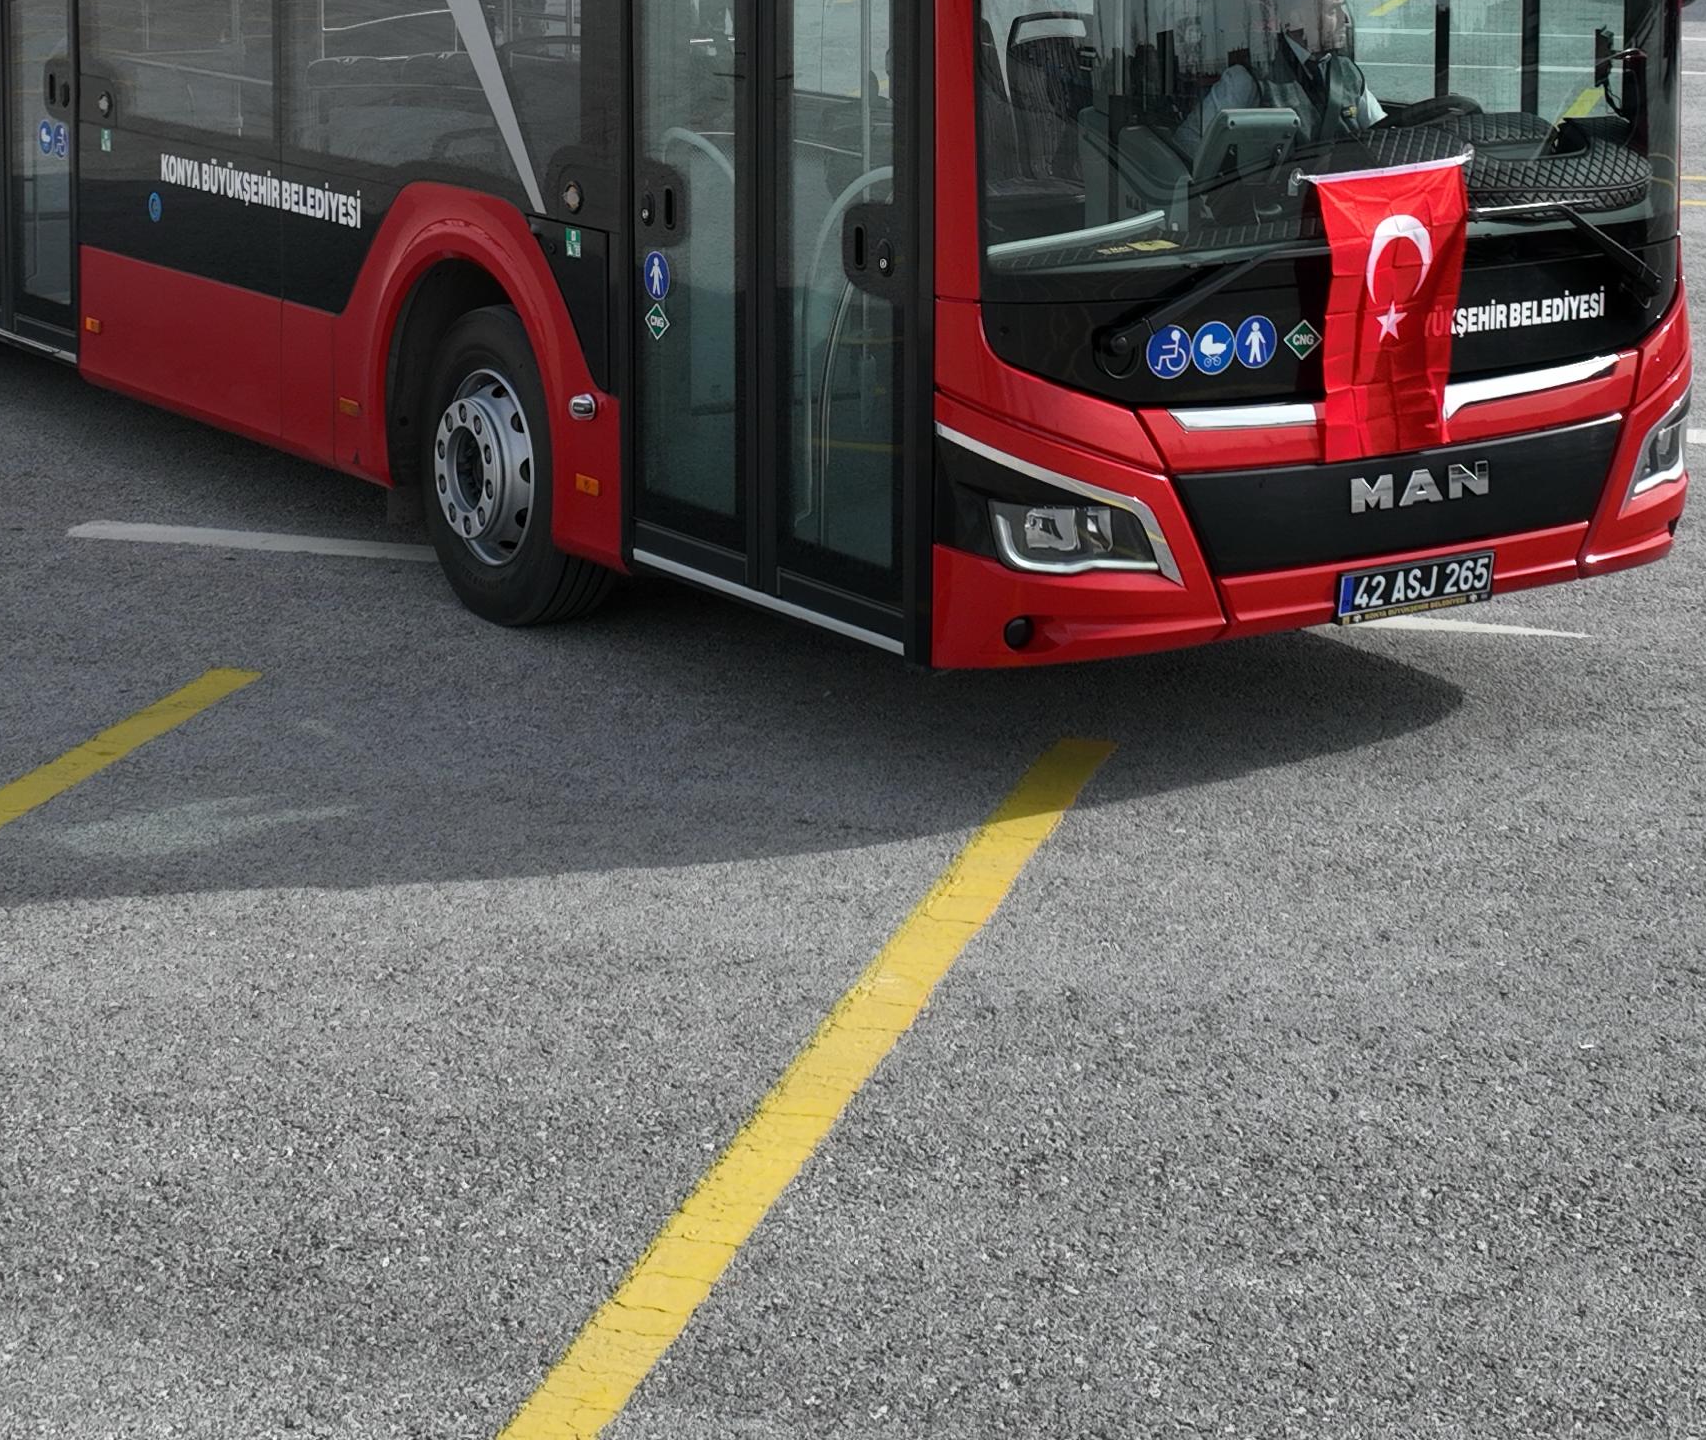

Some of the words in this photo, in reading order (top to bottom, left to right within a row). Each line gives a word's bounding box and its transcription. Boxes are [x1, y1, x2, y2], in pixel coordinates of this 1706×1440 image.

[160, 153, 201, 190] KONYA
[201, 157, 281, 208] BÜYÜKŞEHİR
[282, 181, 362, 229] BELEDİYESİ
[1509, 285, 1605, 328] BELEDİYESİ
[1292, 333, 1315, 347] CNG
[1350, 460, 1490, 514] MAN
[1354, 575, 1387, 608] 42
[1390, 565, 1439, 603] ASJ
[1443, 557, 1490, 594] 265
